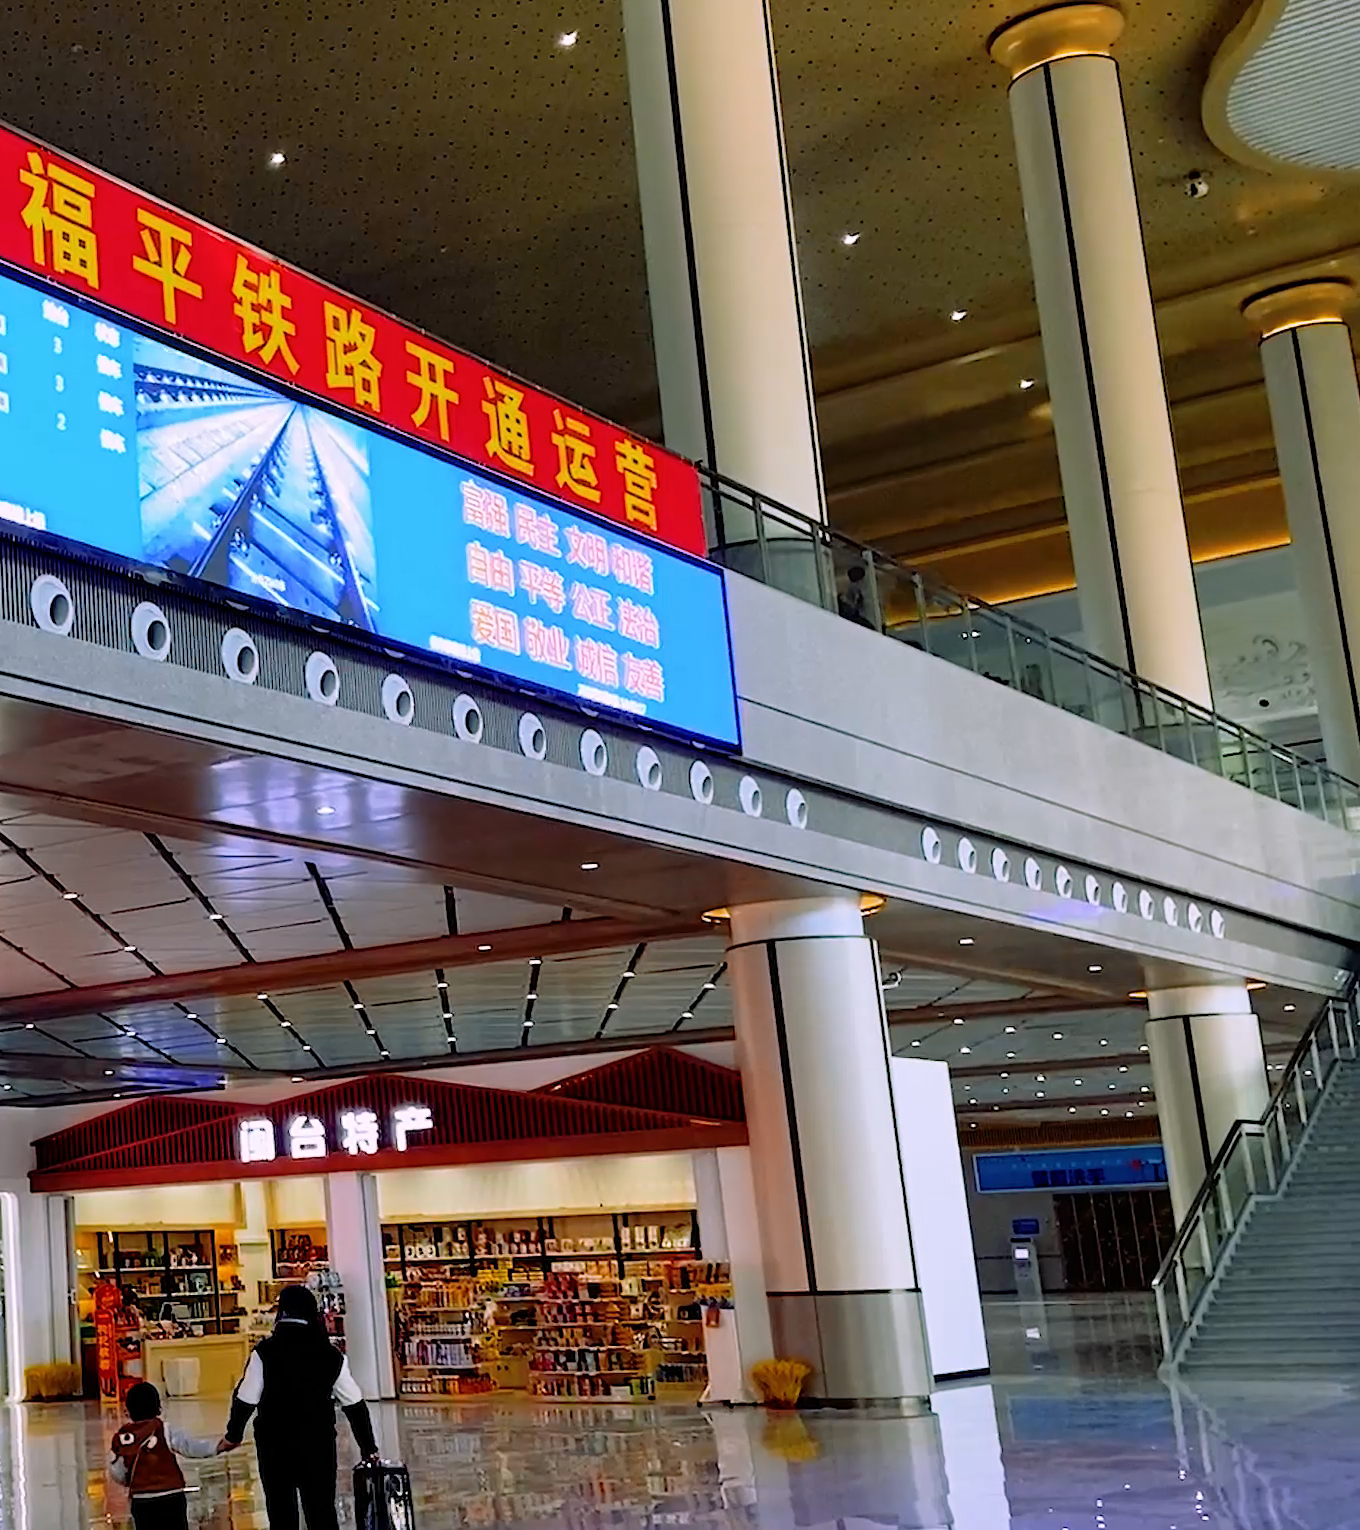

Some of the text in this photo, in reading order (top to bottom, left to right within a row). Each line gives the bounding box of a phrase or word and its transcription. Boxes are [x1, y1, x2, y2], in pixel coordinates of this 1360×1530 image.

[459, 479, 655, 596] 富强 民主 文明 和谐
[466, 541, 660, 649] 自由 平等 公正 法治
[469, 598, 520, 656] 爱国
[523, 616, 572, 671] 敬业
[574, 634, 619, 688] 诚信
[621, 651, 665, 703] 友善
